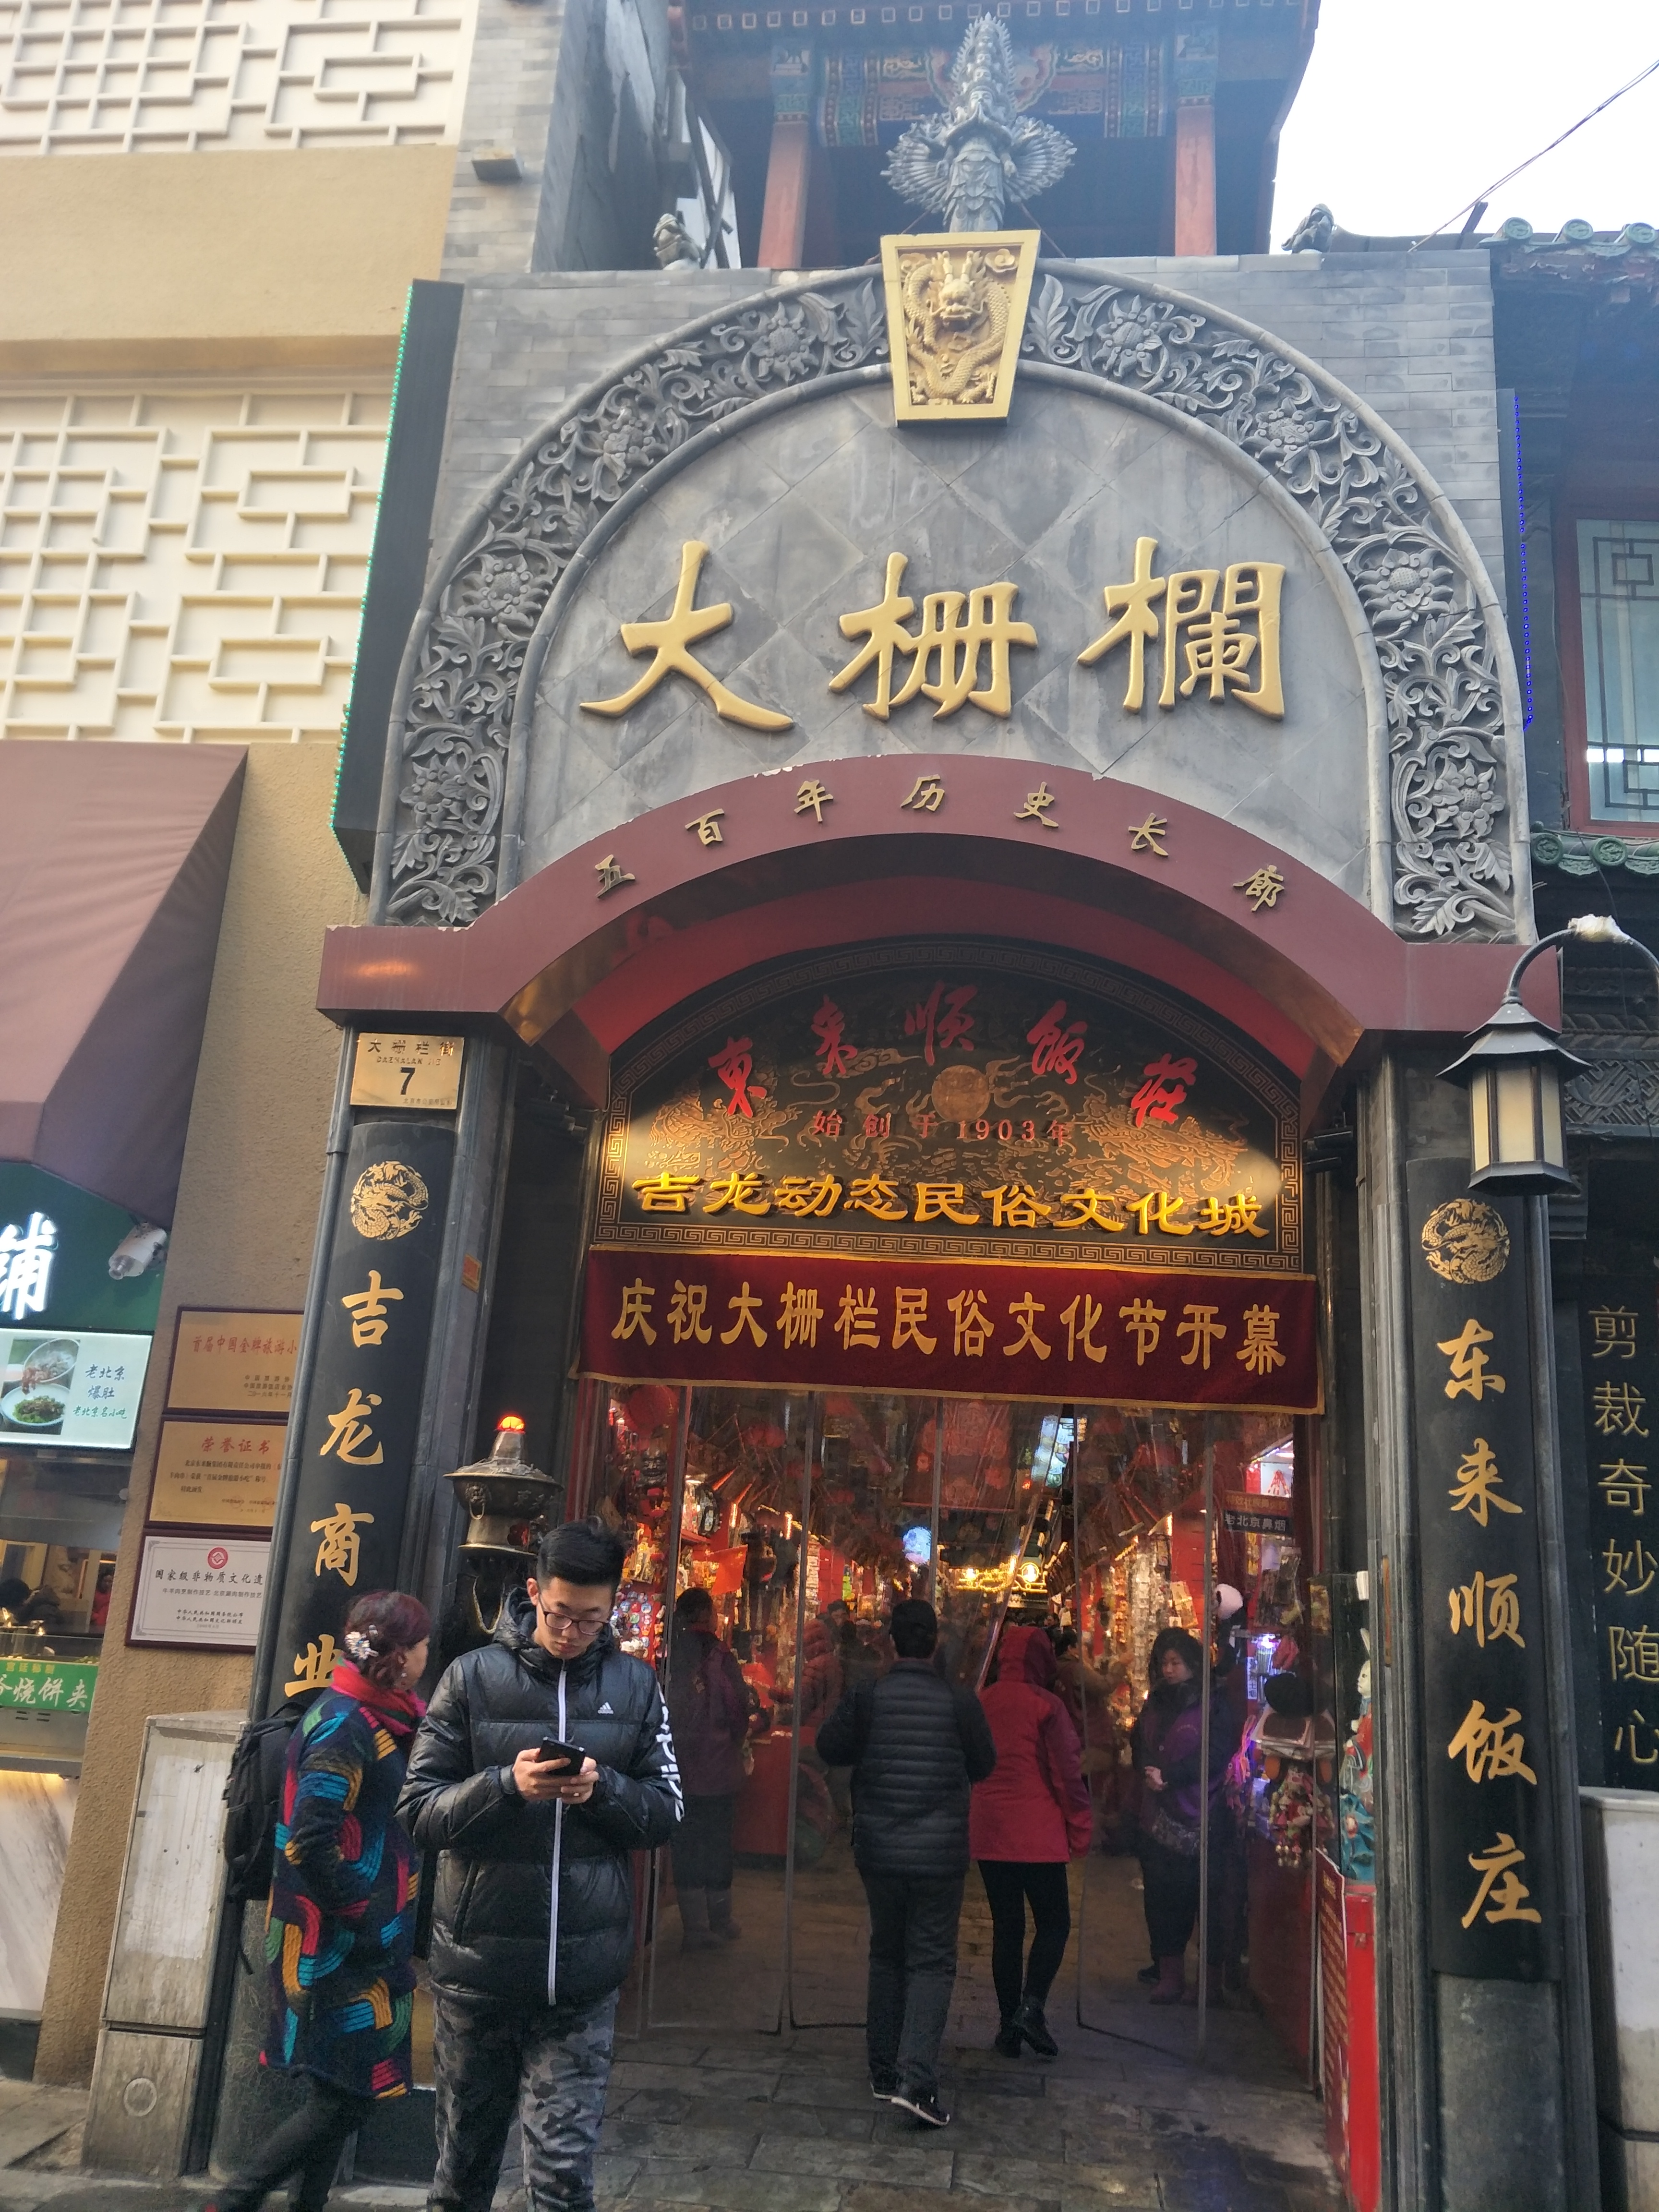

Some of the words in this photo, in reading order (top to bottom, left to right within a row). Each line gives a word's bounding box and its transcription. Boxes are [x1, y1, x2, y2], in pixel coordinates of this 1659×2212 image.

[400, 1067, 416, 1095] 7
[813, 1108, 1070, 1148] 始创于1903年
[632, 1171, 1270, 1238] 吉龙动态民俗文化城
[611, 1278, 1286, 1376] 庆祝大栅栏民俗文化节开幕
[84, 1364, 126, 1381] 老北京
[87, 1384, 115, 1399] 爆肚
[72, 1405, 128, 1419] 老北京名小吃
[202, 1436, 270, 1454] 荣誉证书
[1225, 1514, 1286, 1532] 老北京鼻烟
[1588, 1305, 1659, 1765] 剪裁奇妙随心
[1437, 1318, 1542, 1930] 东来顺饭庄
